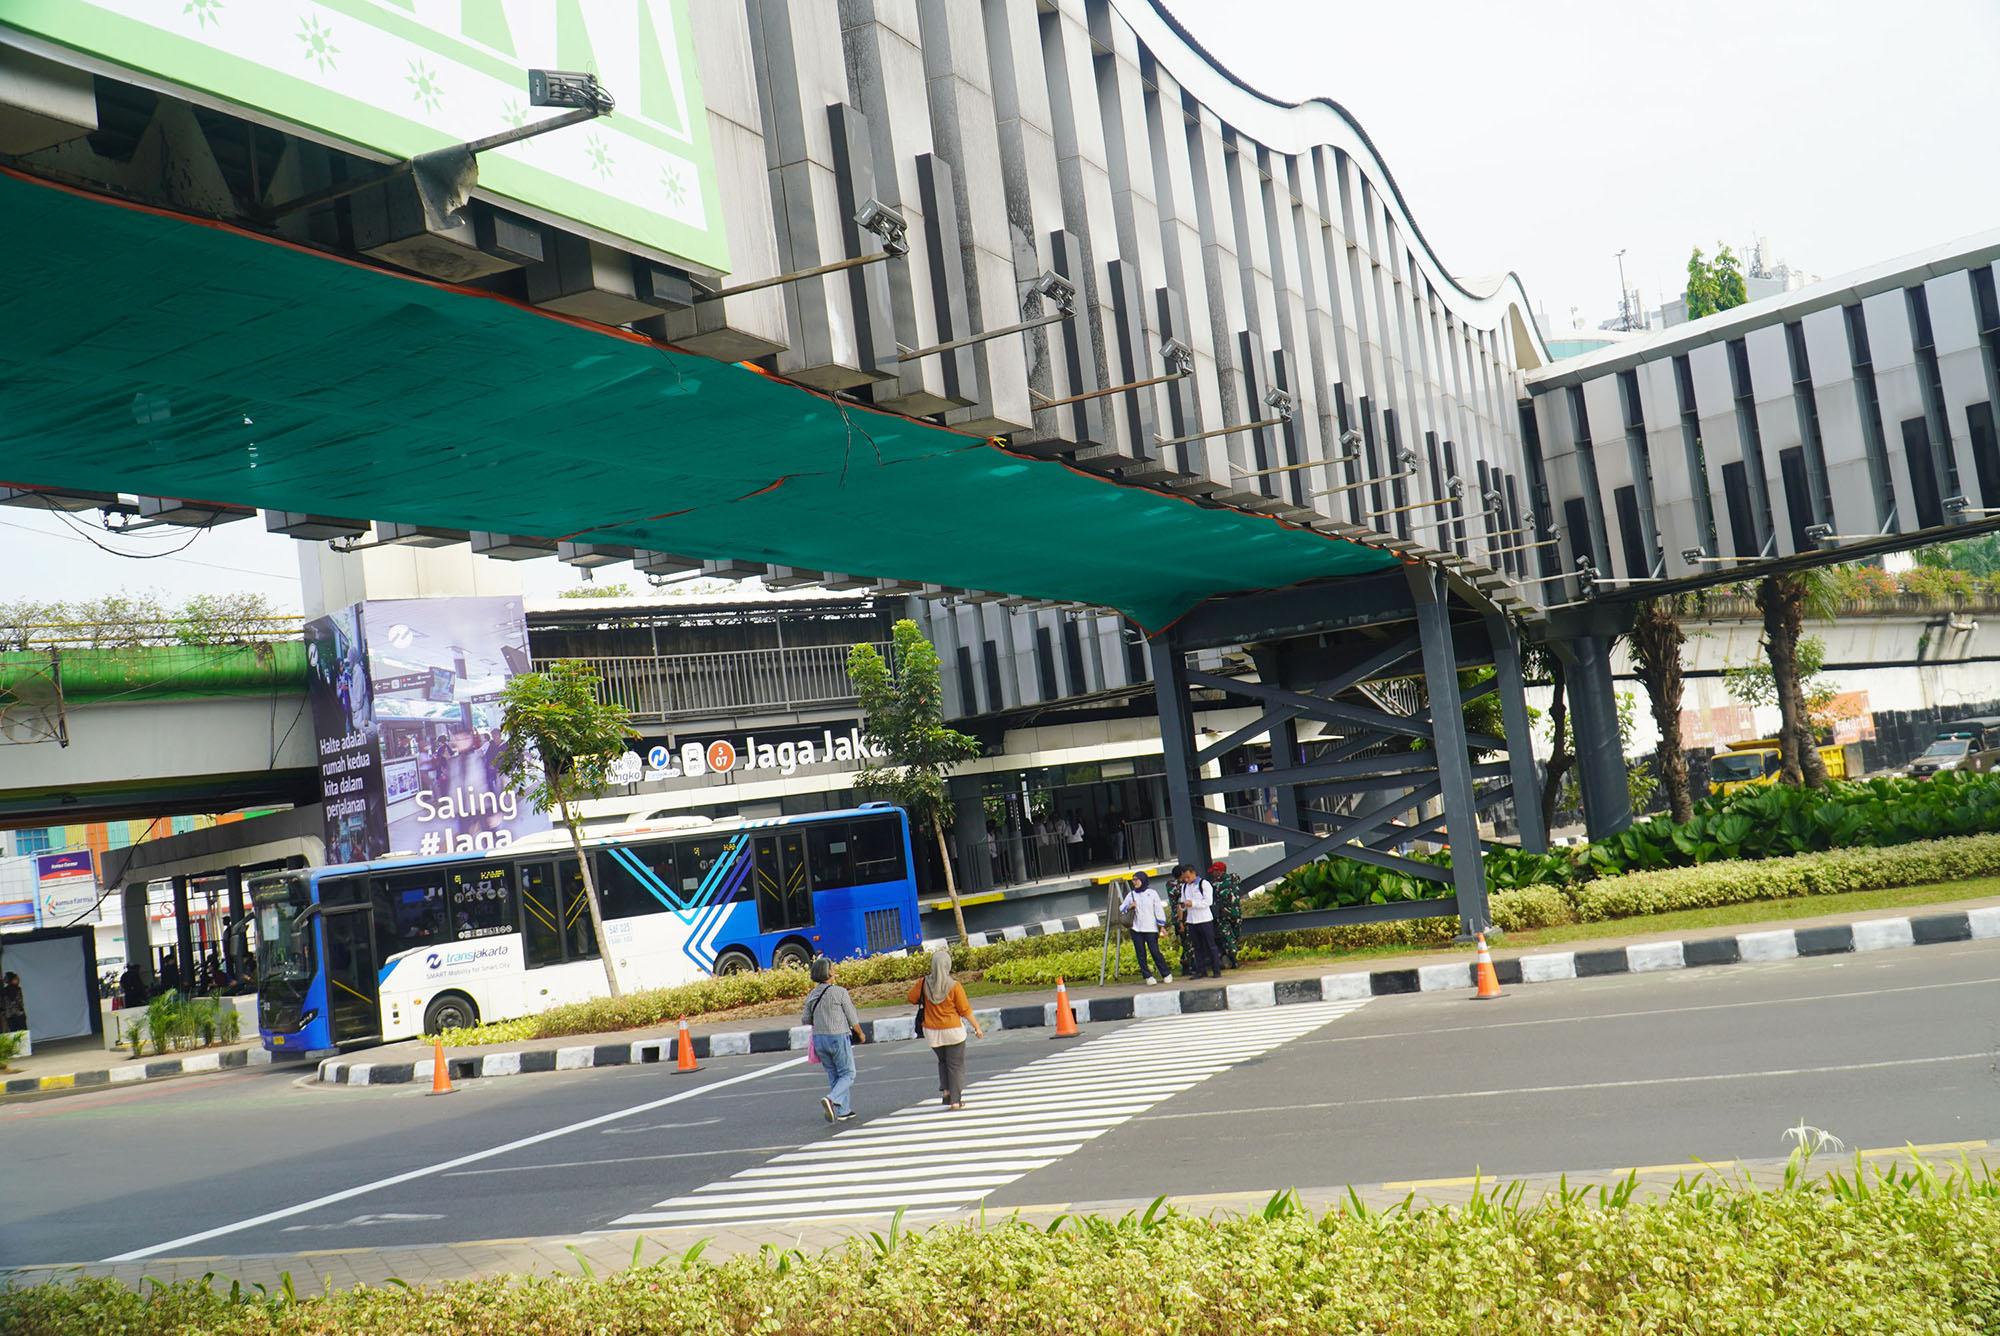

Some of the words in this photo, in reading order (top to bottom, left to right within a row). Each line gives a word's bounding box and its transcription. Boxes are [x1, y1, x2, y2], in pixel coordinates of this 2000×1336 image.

[320, 737, 340, 755] Halte
[341, 730, 367, 750] adalah
[322, 756, 347, 776] rumah
[346, 752, 371, 771] kedua
[715, 756, 728, 767] 07
[744, 737, 815, 775] Jaga
[324, 780, 339, 797] kita
[340, 776, 364, 793] dalam
[326, 798, 366, 822] perjalanan
[415, 786, 518, 821] Saling
[446, 946, 508, 966] transjakarta
[426, 971, 446, 979] SMART
